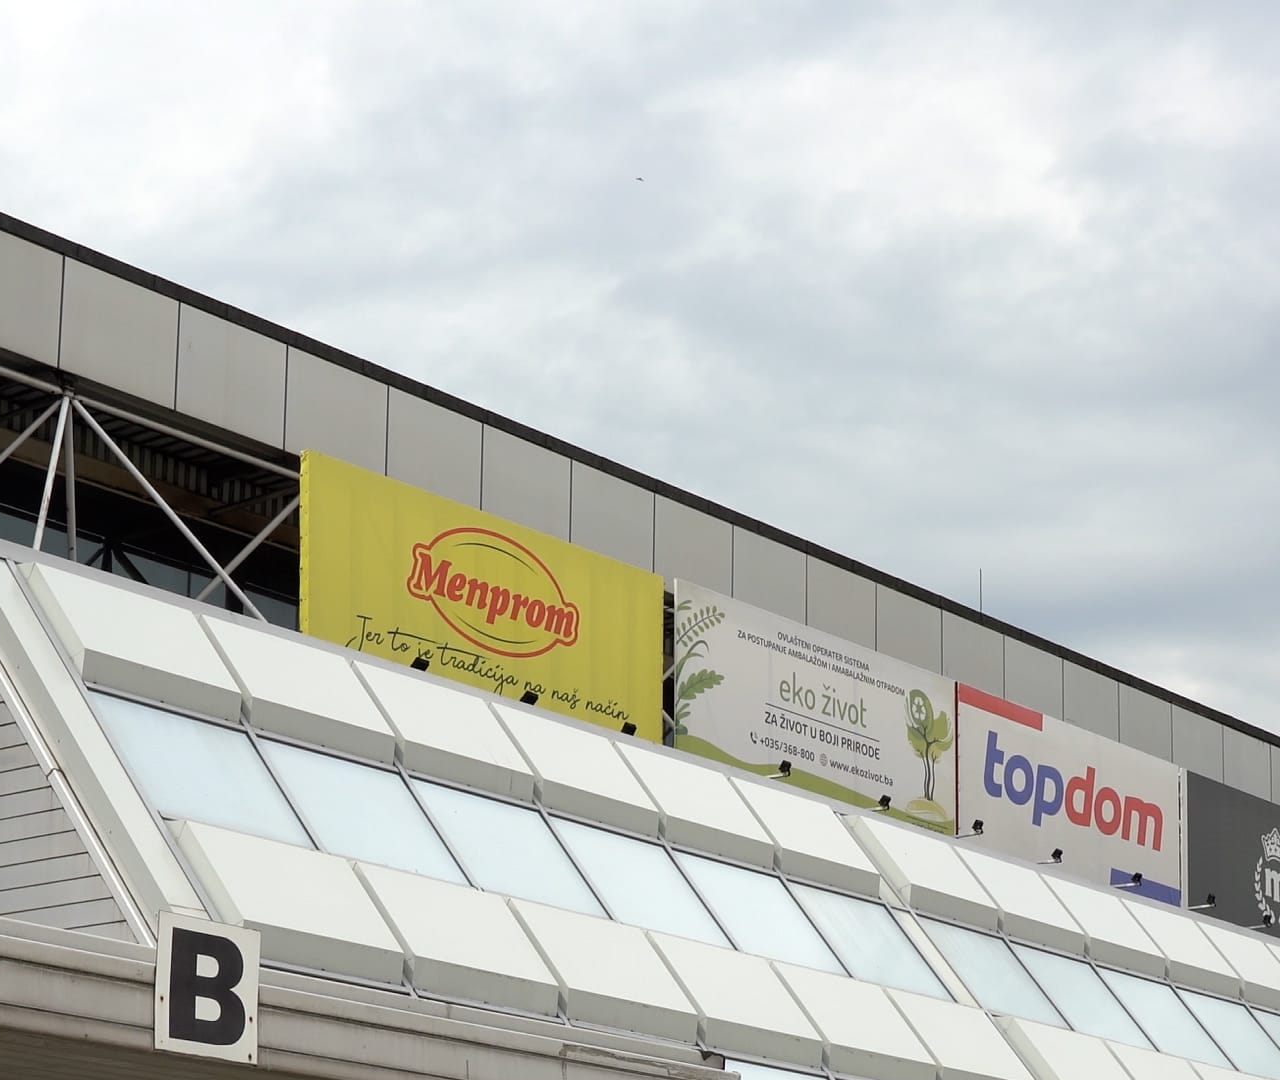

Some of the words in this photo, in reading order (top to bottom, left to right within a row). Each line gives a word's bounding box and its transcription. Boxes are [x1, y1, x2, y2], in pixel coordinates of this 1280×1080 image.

[413, 551, 575, 639] Menprom
[345, 614, 385, 652] Jer
[437, 642, 519, 696] tradicija
[524, 681, 546, 695] na
[552, 688, 581, 710] naš
[586, 697, 630, 721] način
[737, 630, 746, 639] ZA
[747, 633, 787, 655] POSTUPANJE
[876, 679, 906, 697] OTPADOM
[777, 631, 811, 651] OVLAŠTENI
[812, 644, 843, 662] OPERATER
[844, 655, 870, 671] SISTEMA
[779, 672, 816, 711] eko
[821, 683, 867, 728] život
[759, 736, 815, 762] +035/368-800
[764, 711, 777, 726] ZA
[779, 713, 808, 735] ŽIVOT
[810, 727, 817, 739] U
[819, 729, 839, 747] BOJI
[841, 736, 881, 760] PRIRODE
[830, 758, 894, 786] www.ekozivot.ba
[984, 730, 1163, 851] topdom
[169, 927, 246, 1046] B
